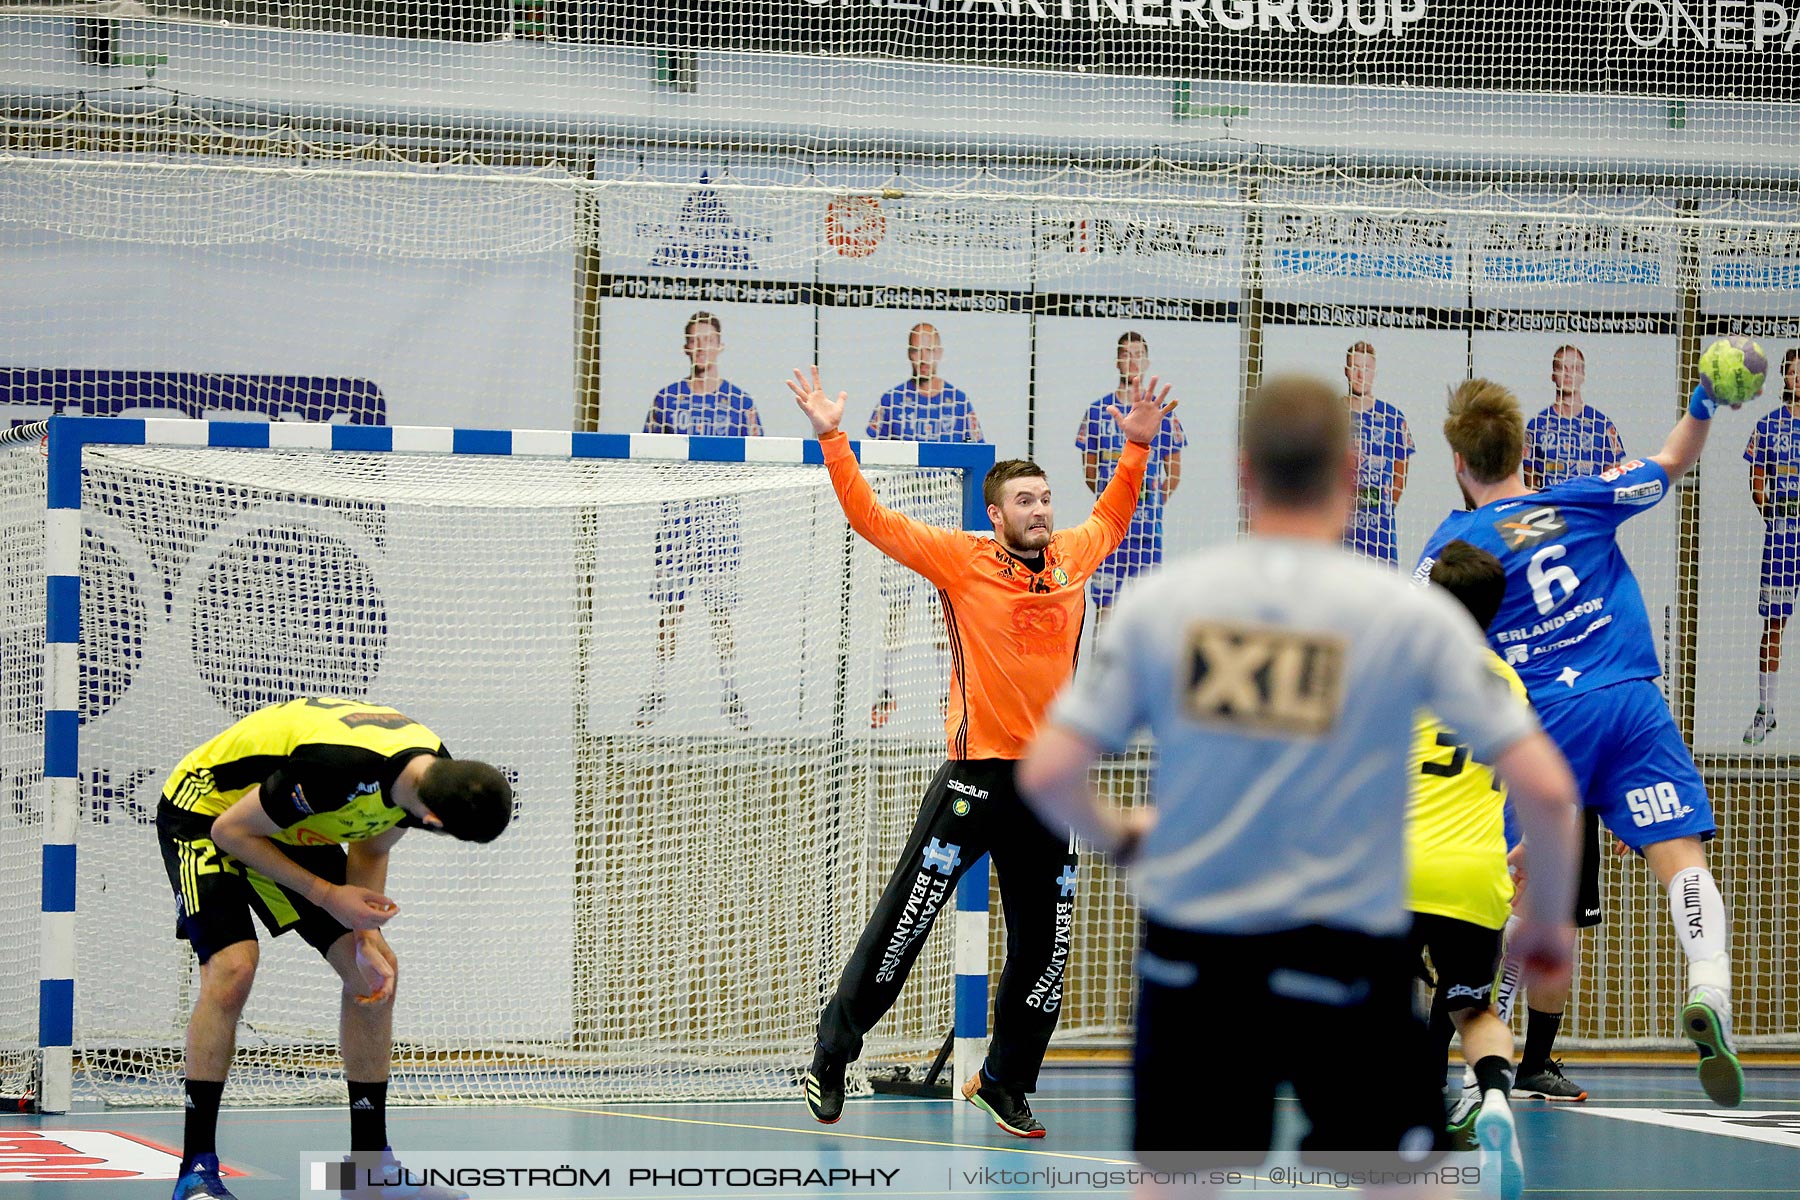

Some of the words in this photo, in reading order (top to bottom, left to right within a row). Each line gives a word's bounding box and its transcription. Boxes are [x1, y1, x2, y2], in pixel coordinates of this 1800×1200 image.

[740, 284, 795, 303] Jepsen
[873, 290, 932, 307] Kristian
[934, 291, 1007, 311] Svensson
[1108, 301, 1142, 316] Jack
[1312, 308, 1332, 322] 18
[1501, 314, 1521, 329] 22
[1570, 316, 1655, 335] Gustavsson
[1744, 321, 1763, 334] 23
[1527, 544, 1581, 616] 6
[1496, 597, 1604, 643] ERLANDSSON
[947, 779, 989, 800] stadium
[1684, 874, 1704, 940] SALMING
[876, 871, 931, 984] BEMANNING
[1026, 902, 1073, 1008] BEMANNING
